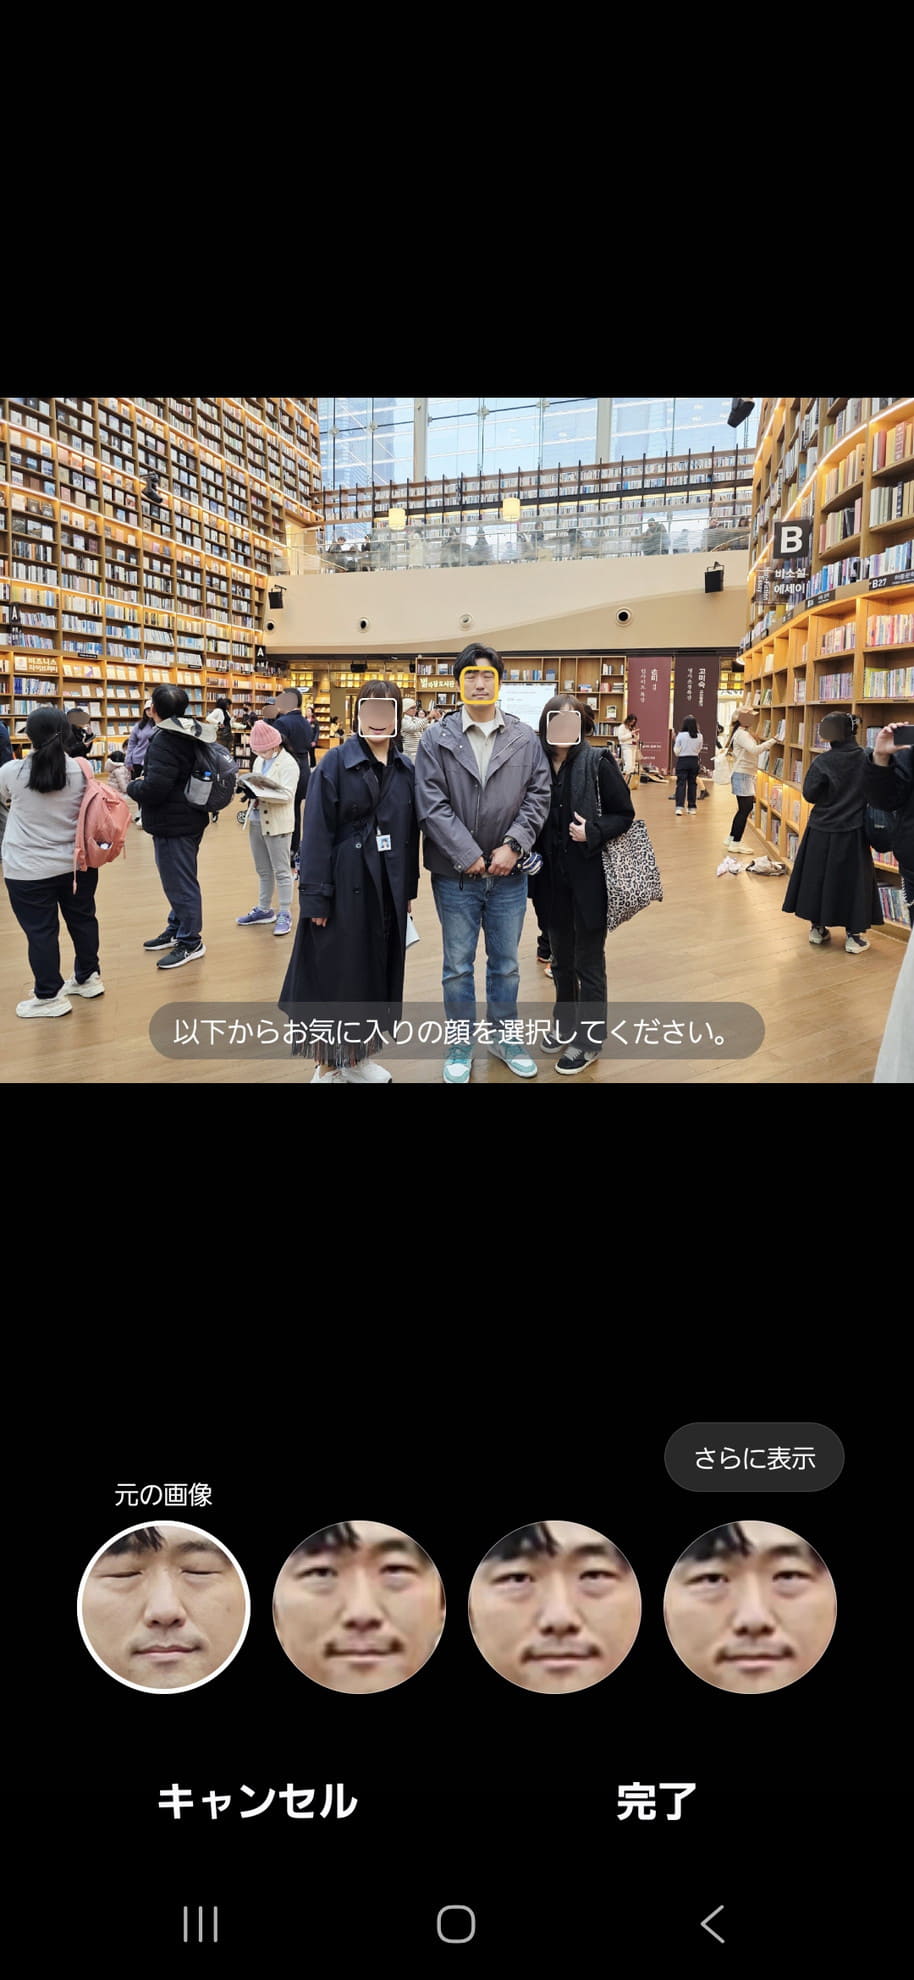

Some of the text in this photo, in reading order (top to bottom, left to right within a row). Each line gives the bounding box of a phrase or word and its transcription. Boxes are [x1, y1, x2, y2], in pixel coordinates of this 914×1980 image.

[780, 525, 803, 554] B
[775, 567, 806, 579] 비소설
[774, 583, 806, 595] 에세이
[872, 578, 887, 589] B27
[11, 605, 18, 620] A
[257, 647, 264, 657] A
